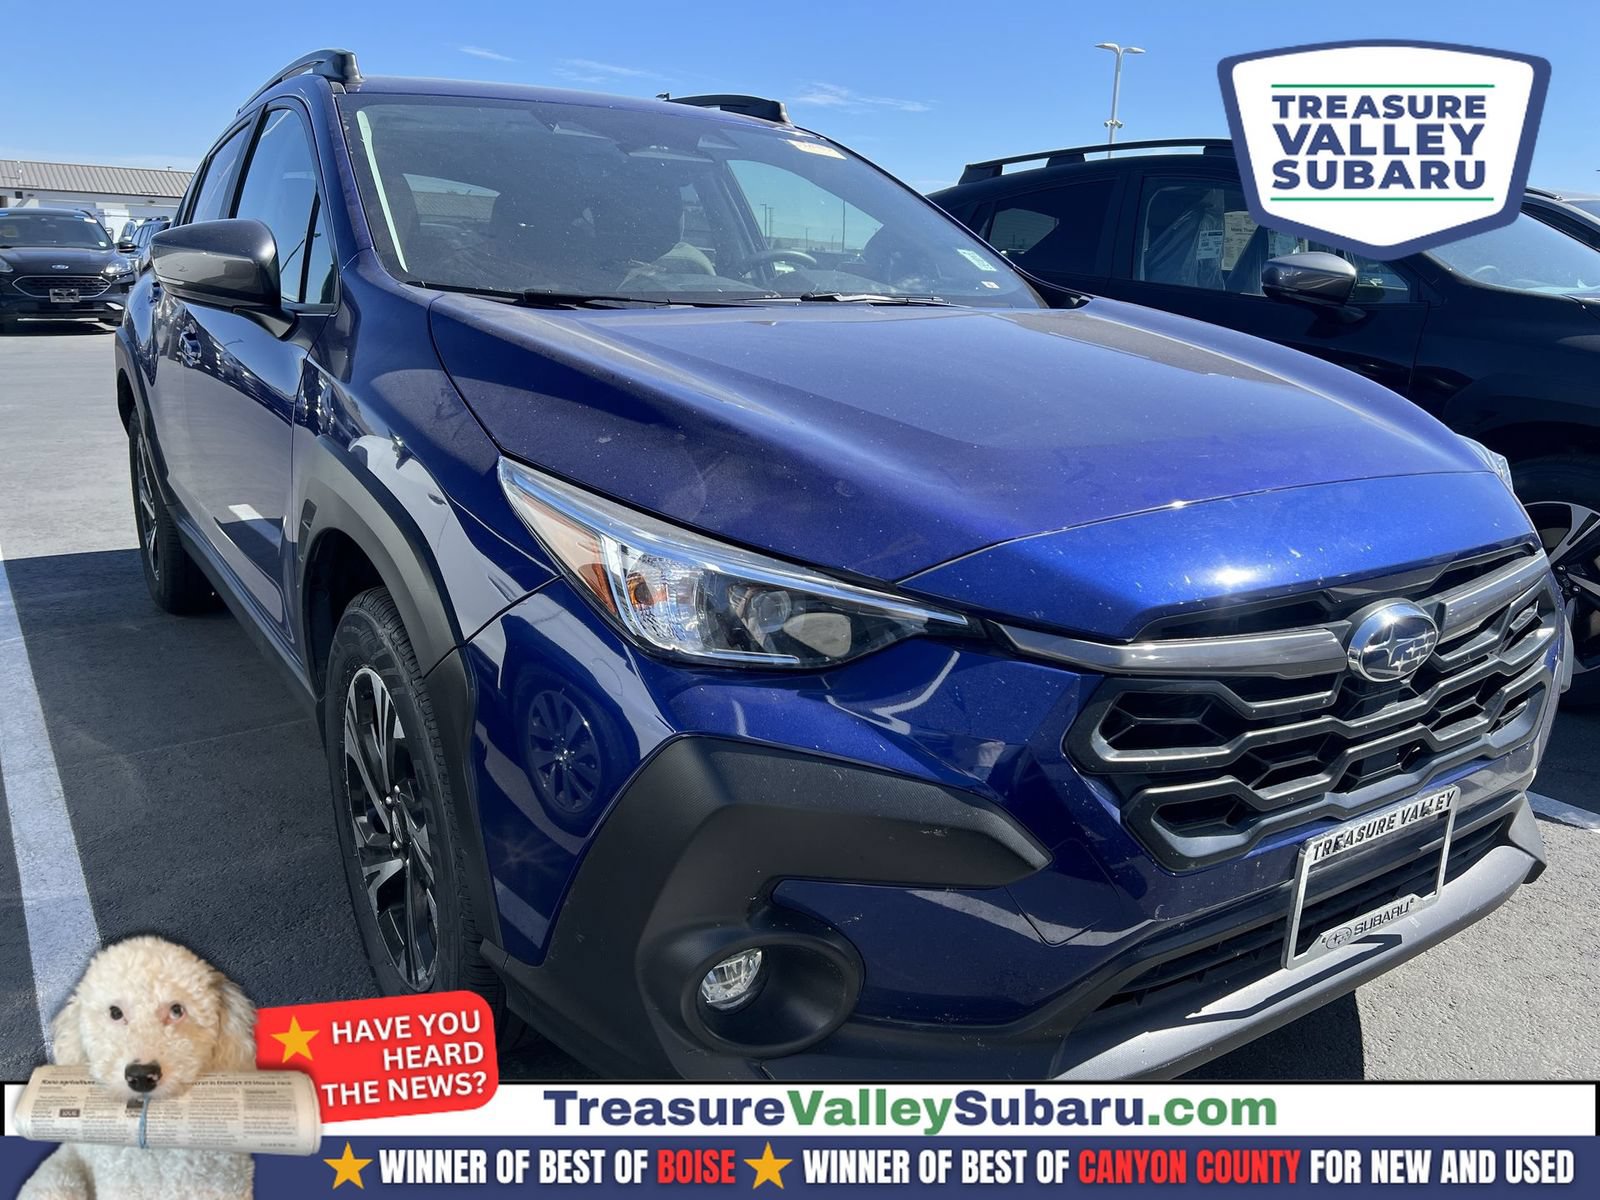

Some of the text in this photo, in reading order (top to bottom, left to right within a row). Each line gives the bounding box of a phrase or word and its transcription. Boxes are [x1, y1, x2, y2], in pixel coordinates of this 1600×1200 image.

[1312, 790, 1456, 860] TREASURE VALLEY
[1354, 901, 1410, 936] SUBARU
